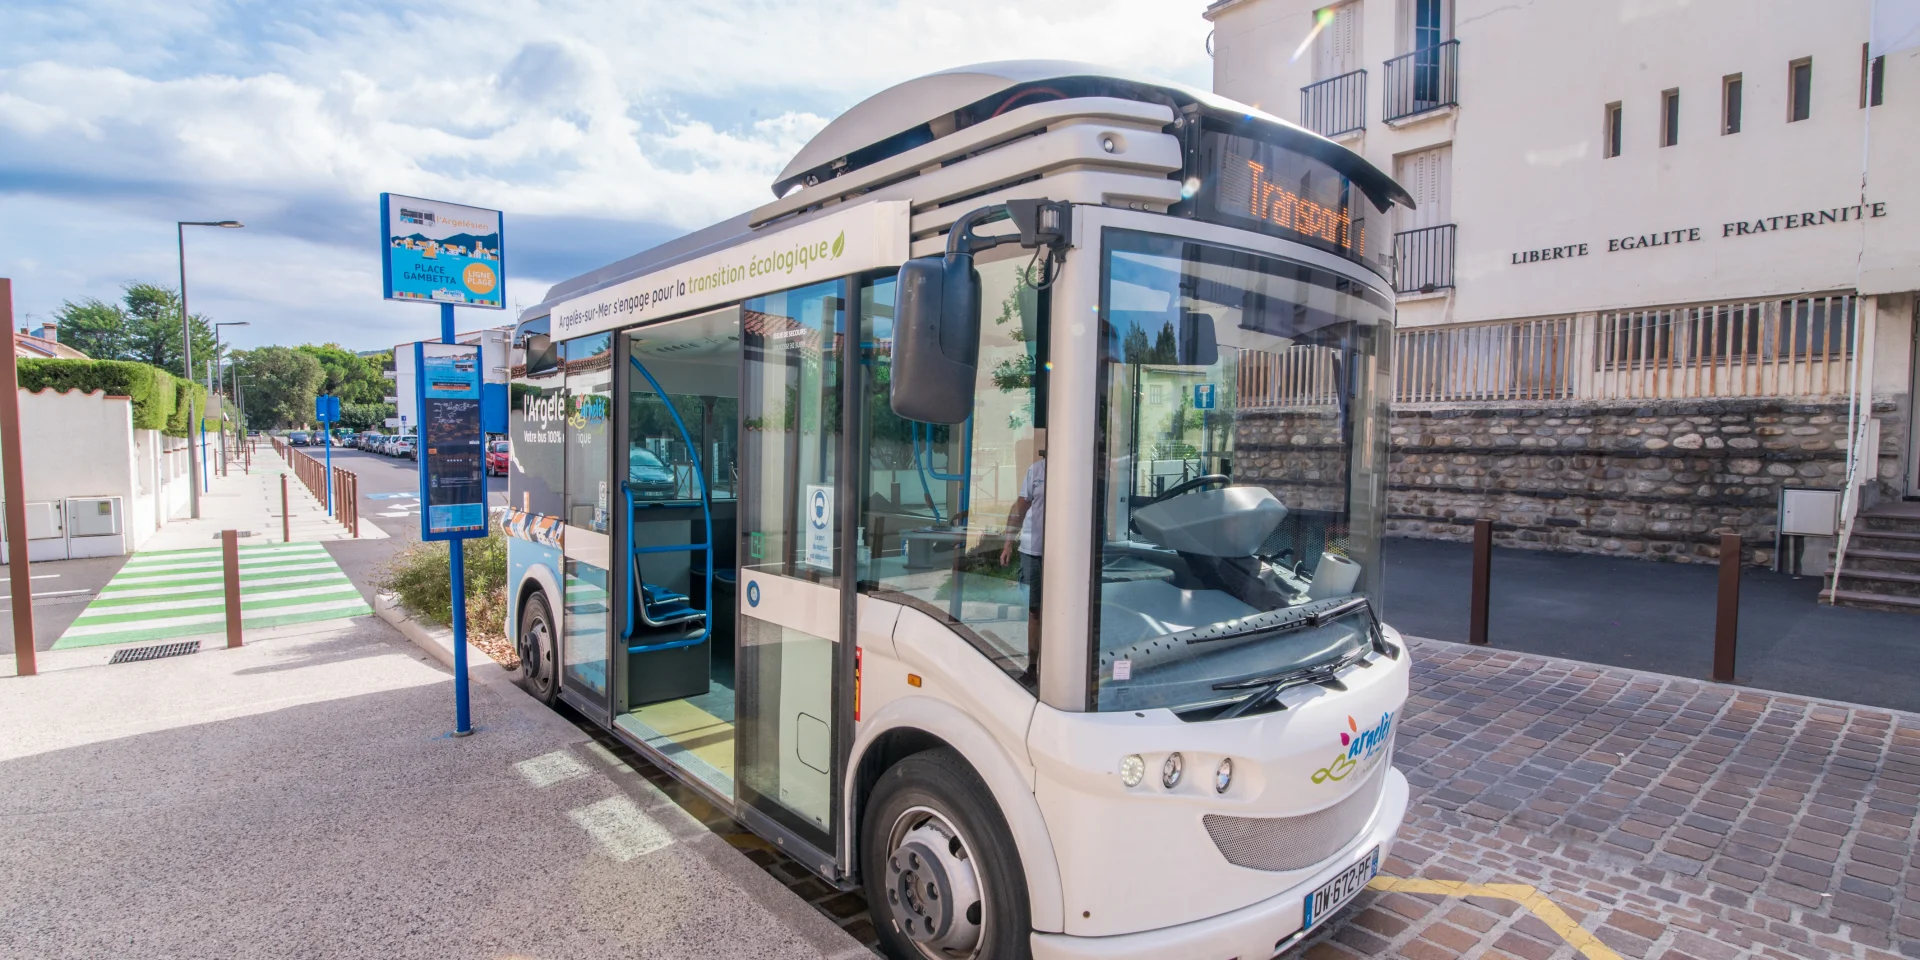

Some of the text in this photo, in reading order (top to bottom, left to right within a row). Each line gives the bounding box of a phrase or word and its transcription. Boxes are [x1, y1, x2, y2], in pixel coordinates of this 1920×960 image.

[1248, 160, 1351, 249] Transport
[436, 216, 488, 230] l'Argelésien
[1511, 201, 1887, 265] LIBERTE EGALITE FRATERNITE
[415, 264, 445, 275] PLACE
[468, 270, 491, 279] LIGNE
[403, 272, 457, 285] GAMBETTA
[467, 277, 493, 287] PLAGE
[559, 240, 828, 331] Argelès-sur-Mer s'engage pour la transition écologique
[524, 388, 564, 430] l'Argelé
[524, 430, 536, 443] Votre
[538, 430, 547, 443] bus
[547, 430, 562, 443] 100%
